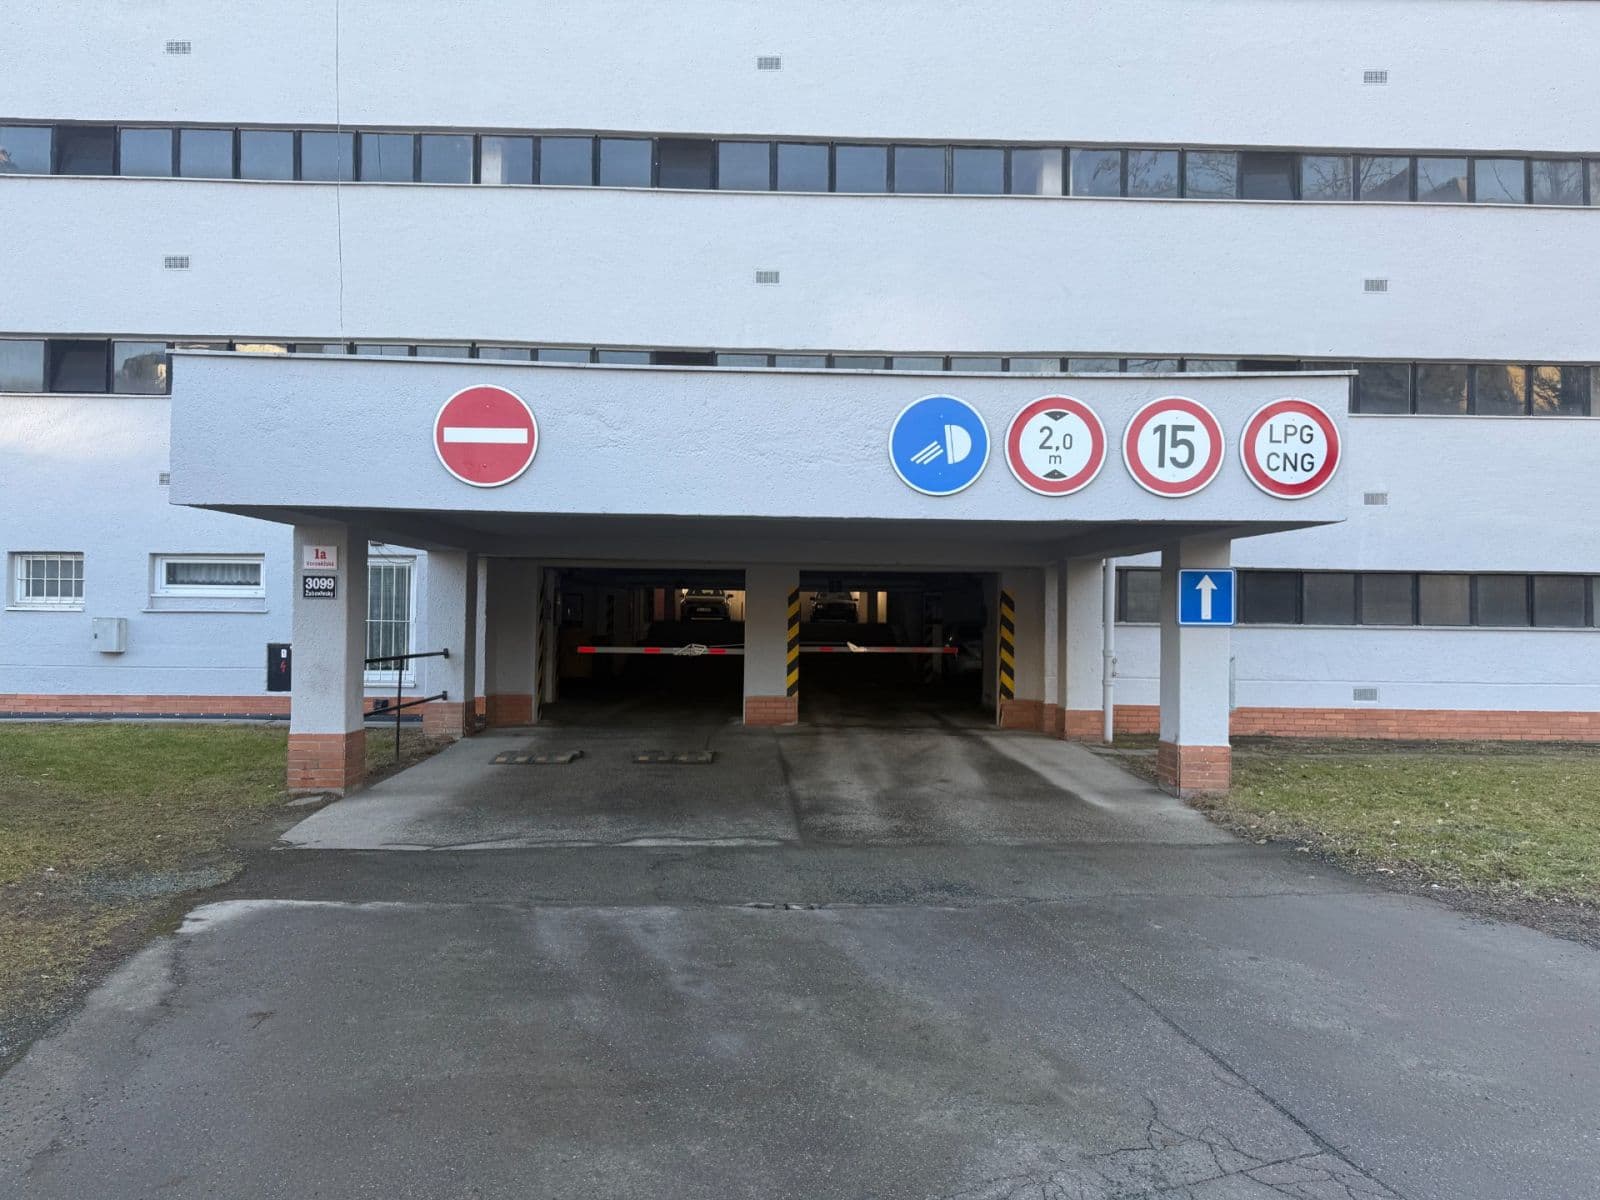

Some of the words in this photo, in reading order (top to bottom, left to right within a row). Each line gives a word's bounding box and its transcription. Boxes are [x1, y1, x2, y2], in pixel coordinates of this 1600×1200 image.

[1039, 426, 1073, 452] 2,0
[1269, 424, 1314, 444] LPG
[1152, 424, 1195, 469] 15
[1049, 455, 1062, 464] m
[1267, 452, 1315, 472] CNG
[315, 549, 327, 559] 1a
[305, 578, 334, 589] 3099
